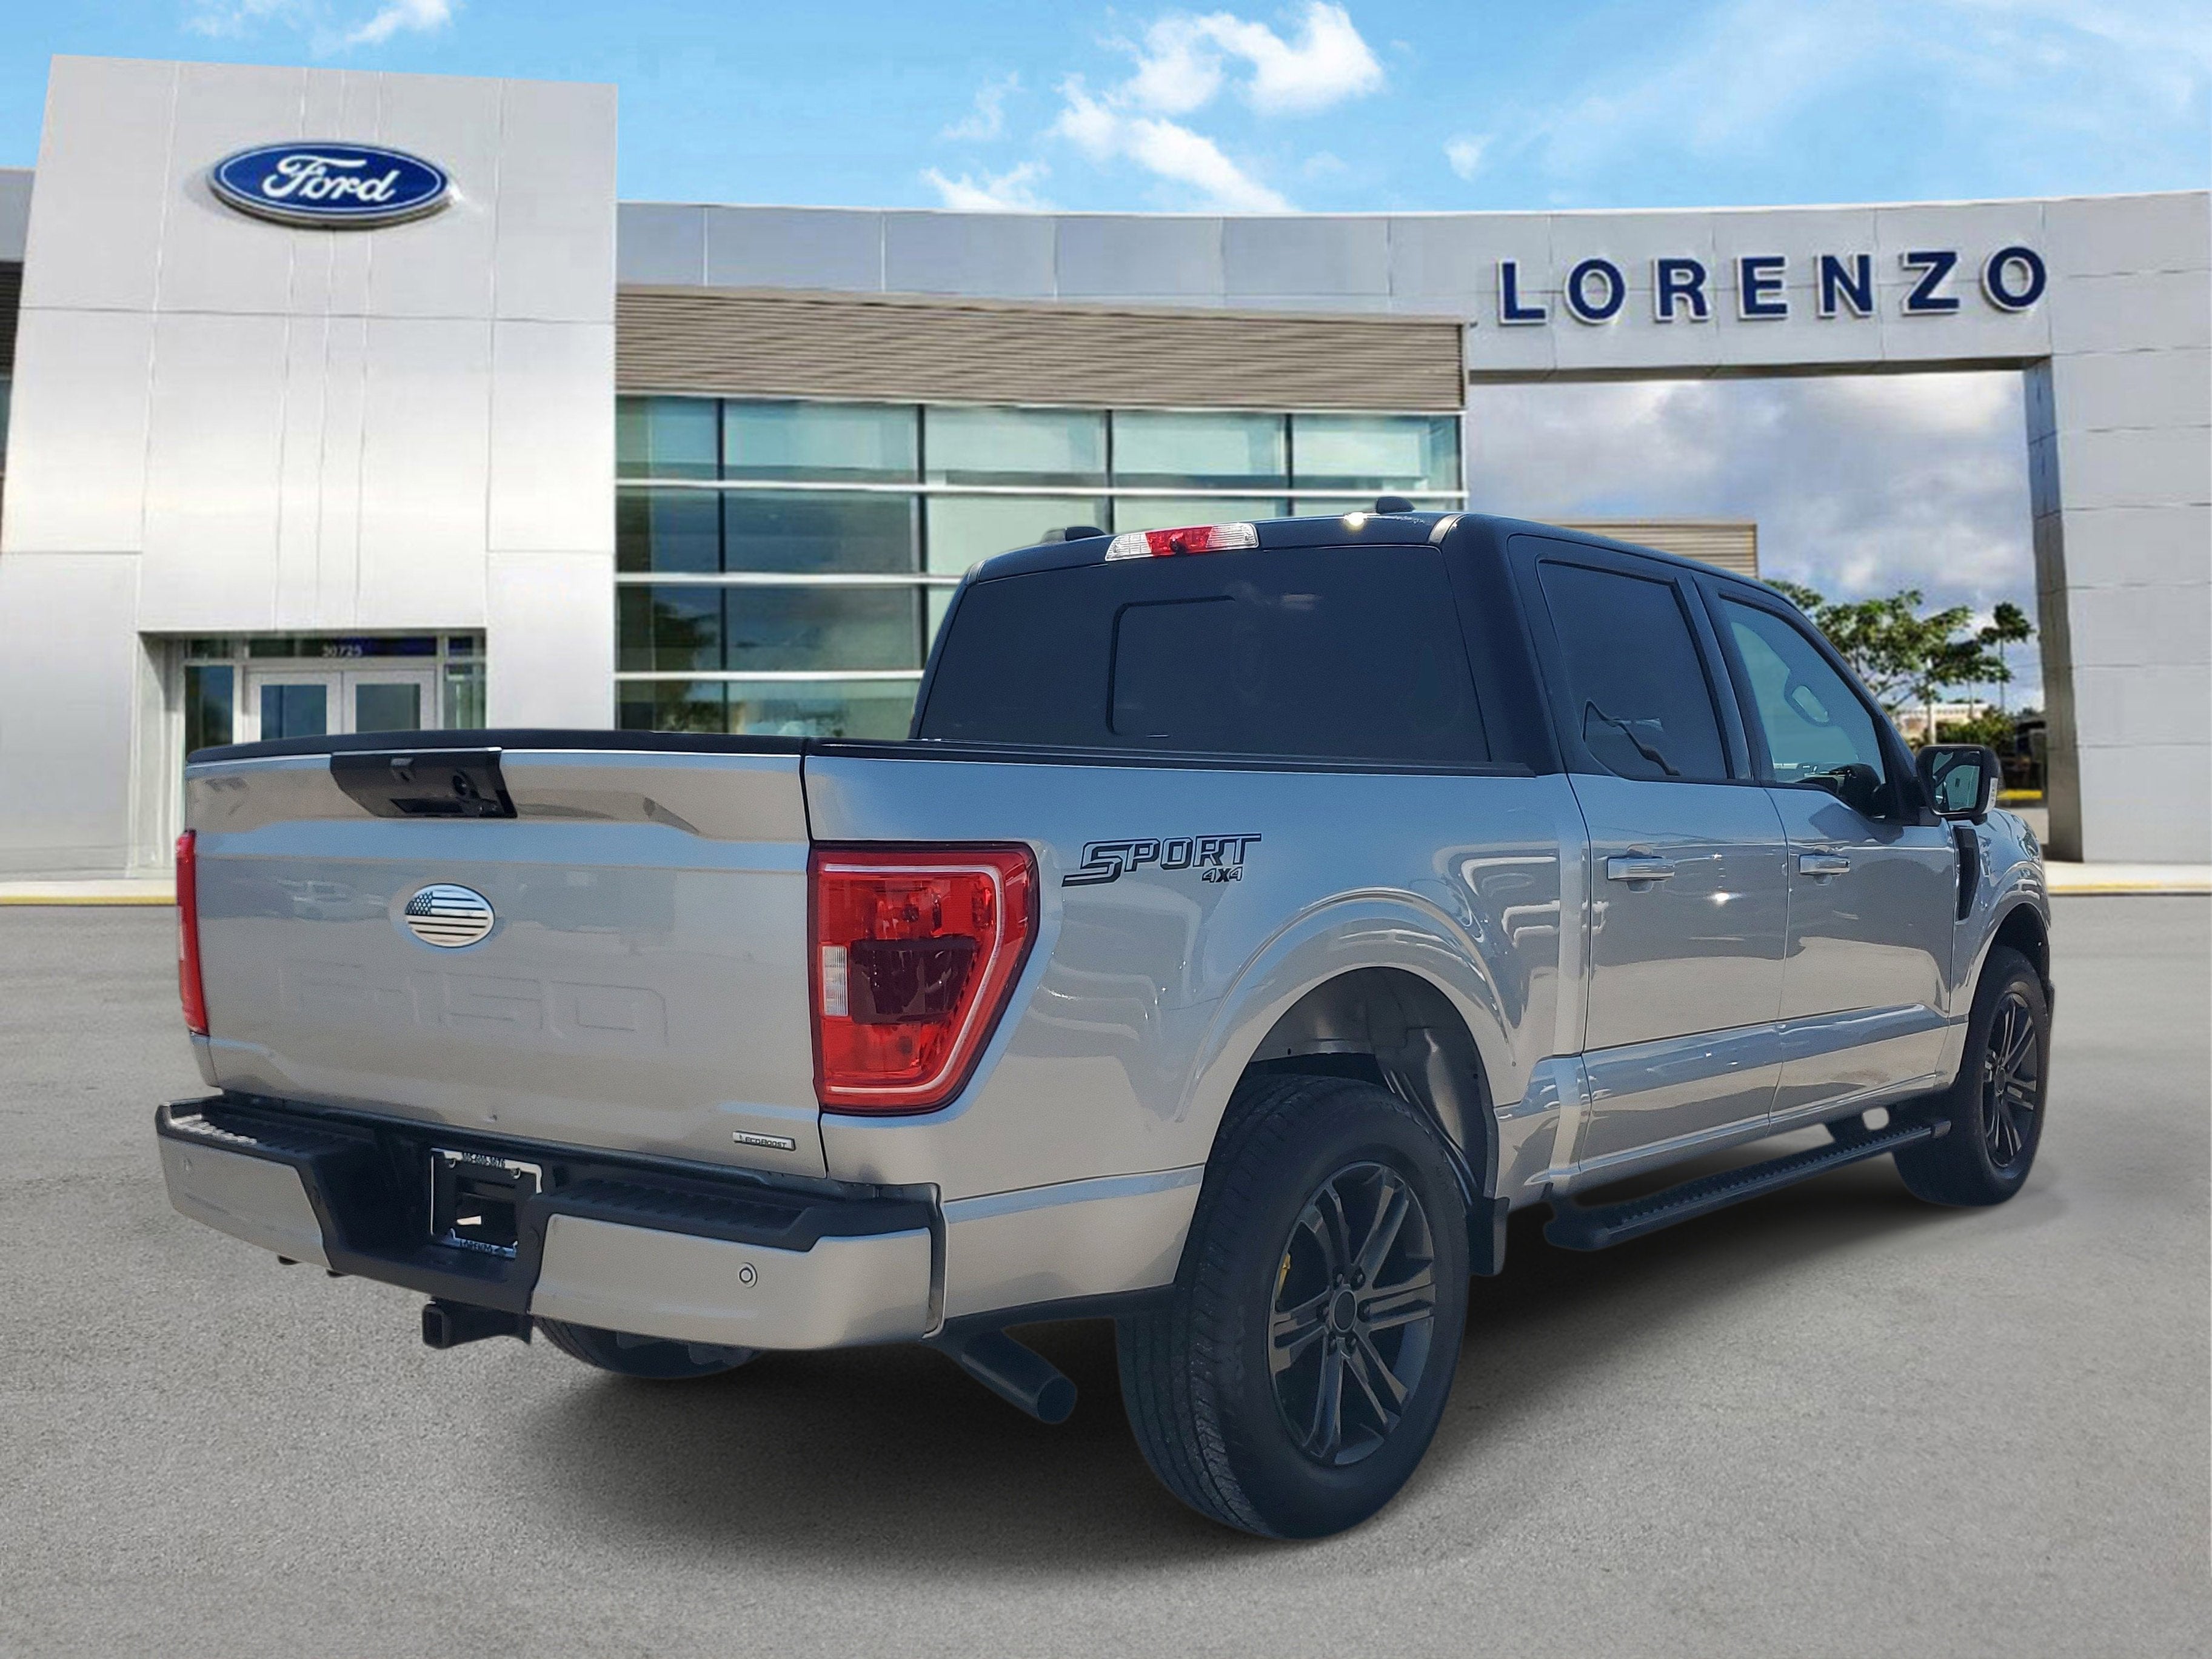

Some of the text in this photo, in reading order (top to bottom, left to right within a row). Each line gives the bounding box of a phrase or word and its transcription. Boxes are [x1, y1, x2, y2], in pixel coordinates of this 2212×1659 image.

[262, 154, 400, 202] Ford
[1495, 246, 2047, 324] LORENZO
[1061, 833, 1261, 887] SPORT
